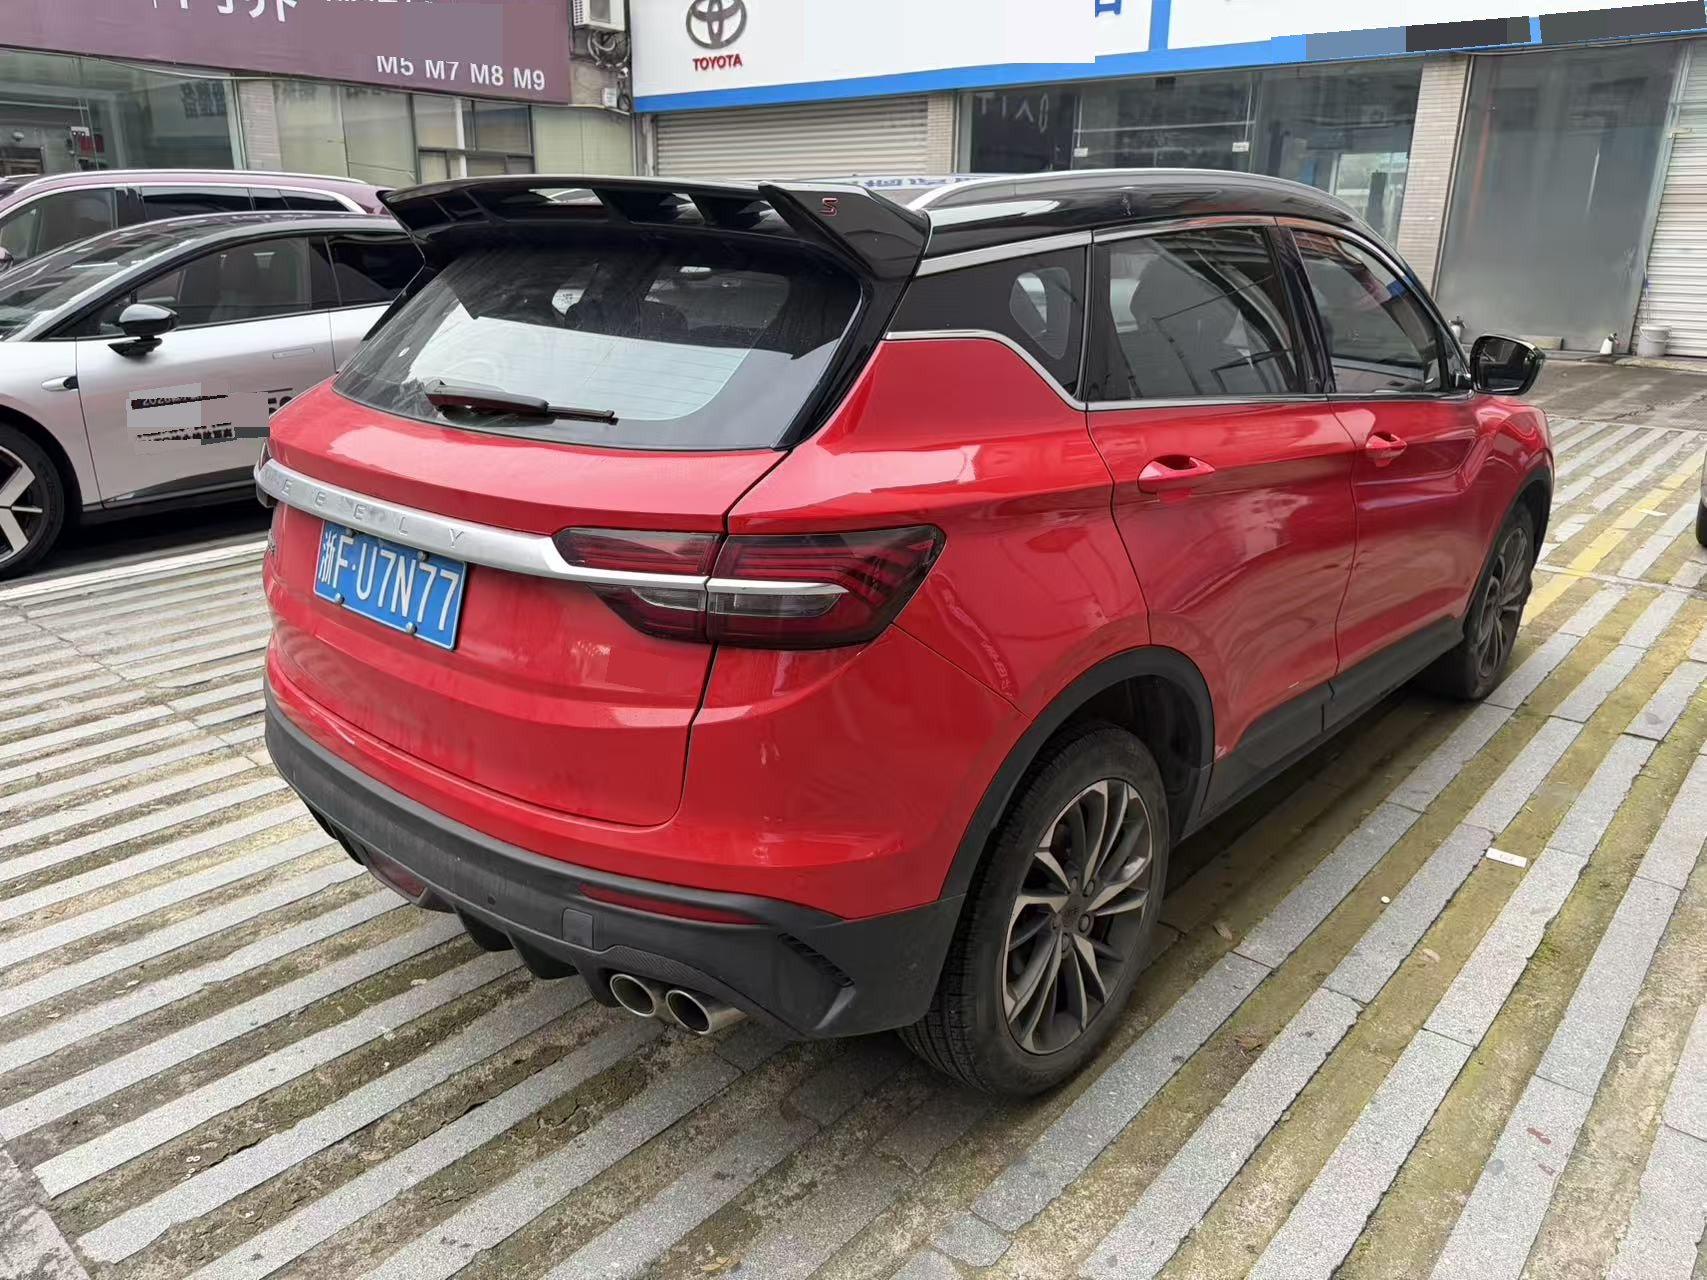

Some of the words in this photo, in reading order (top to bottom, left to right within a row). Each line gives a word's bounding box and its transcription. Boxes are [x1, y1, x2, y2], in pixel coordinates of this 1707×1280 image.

[376, 55, 414, 76] M5
[425, 59, 459, 81] M7
[470, 62, 504, 86] M8
[513, 67, 545, 91] M9
[692, 53, 743, 71] TOYOTA
